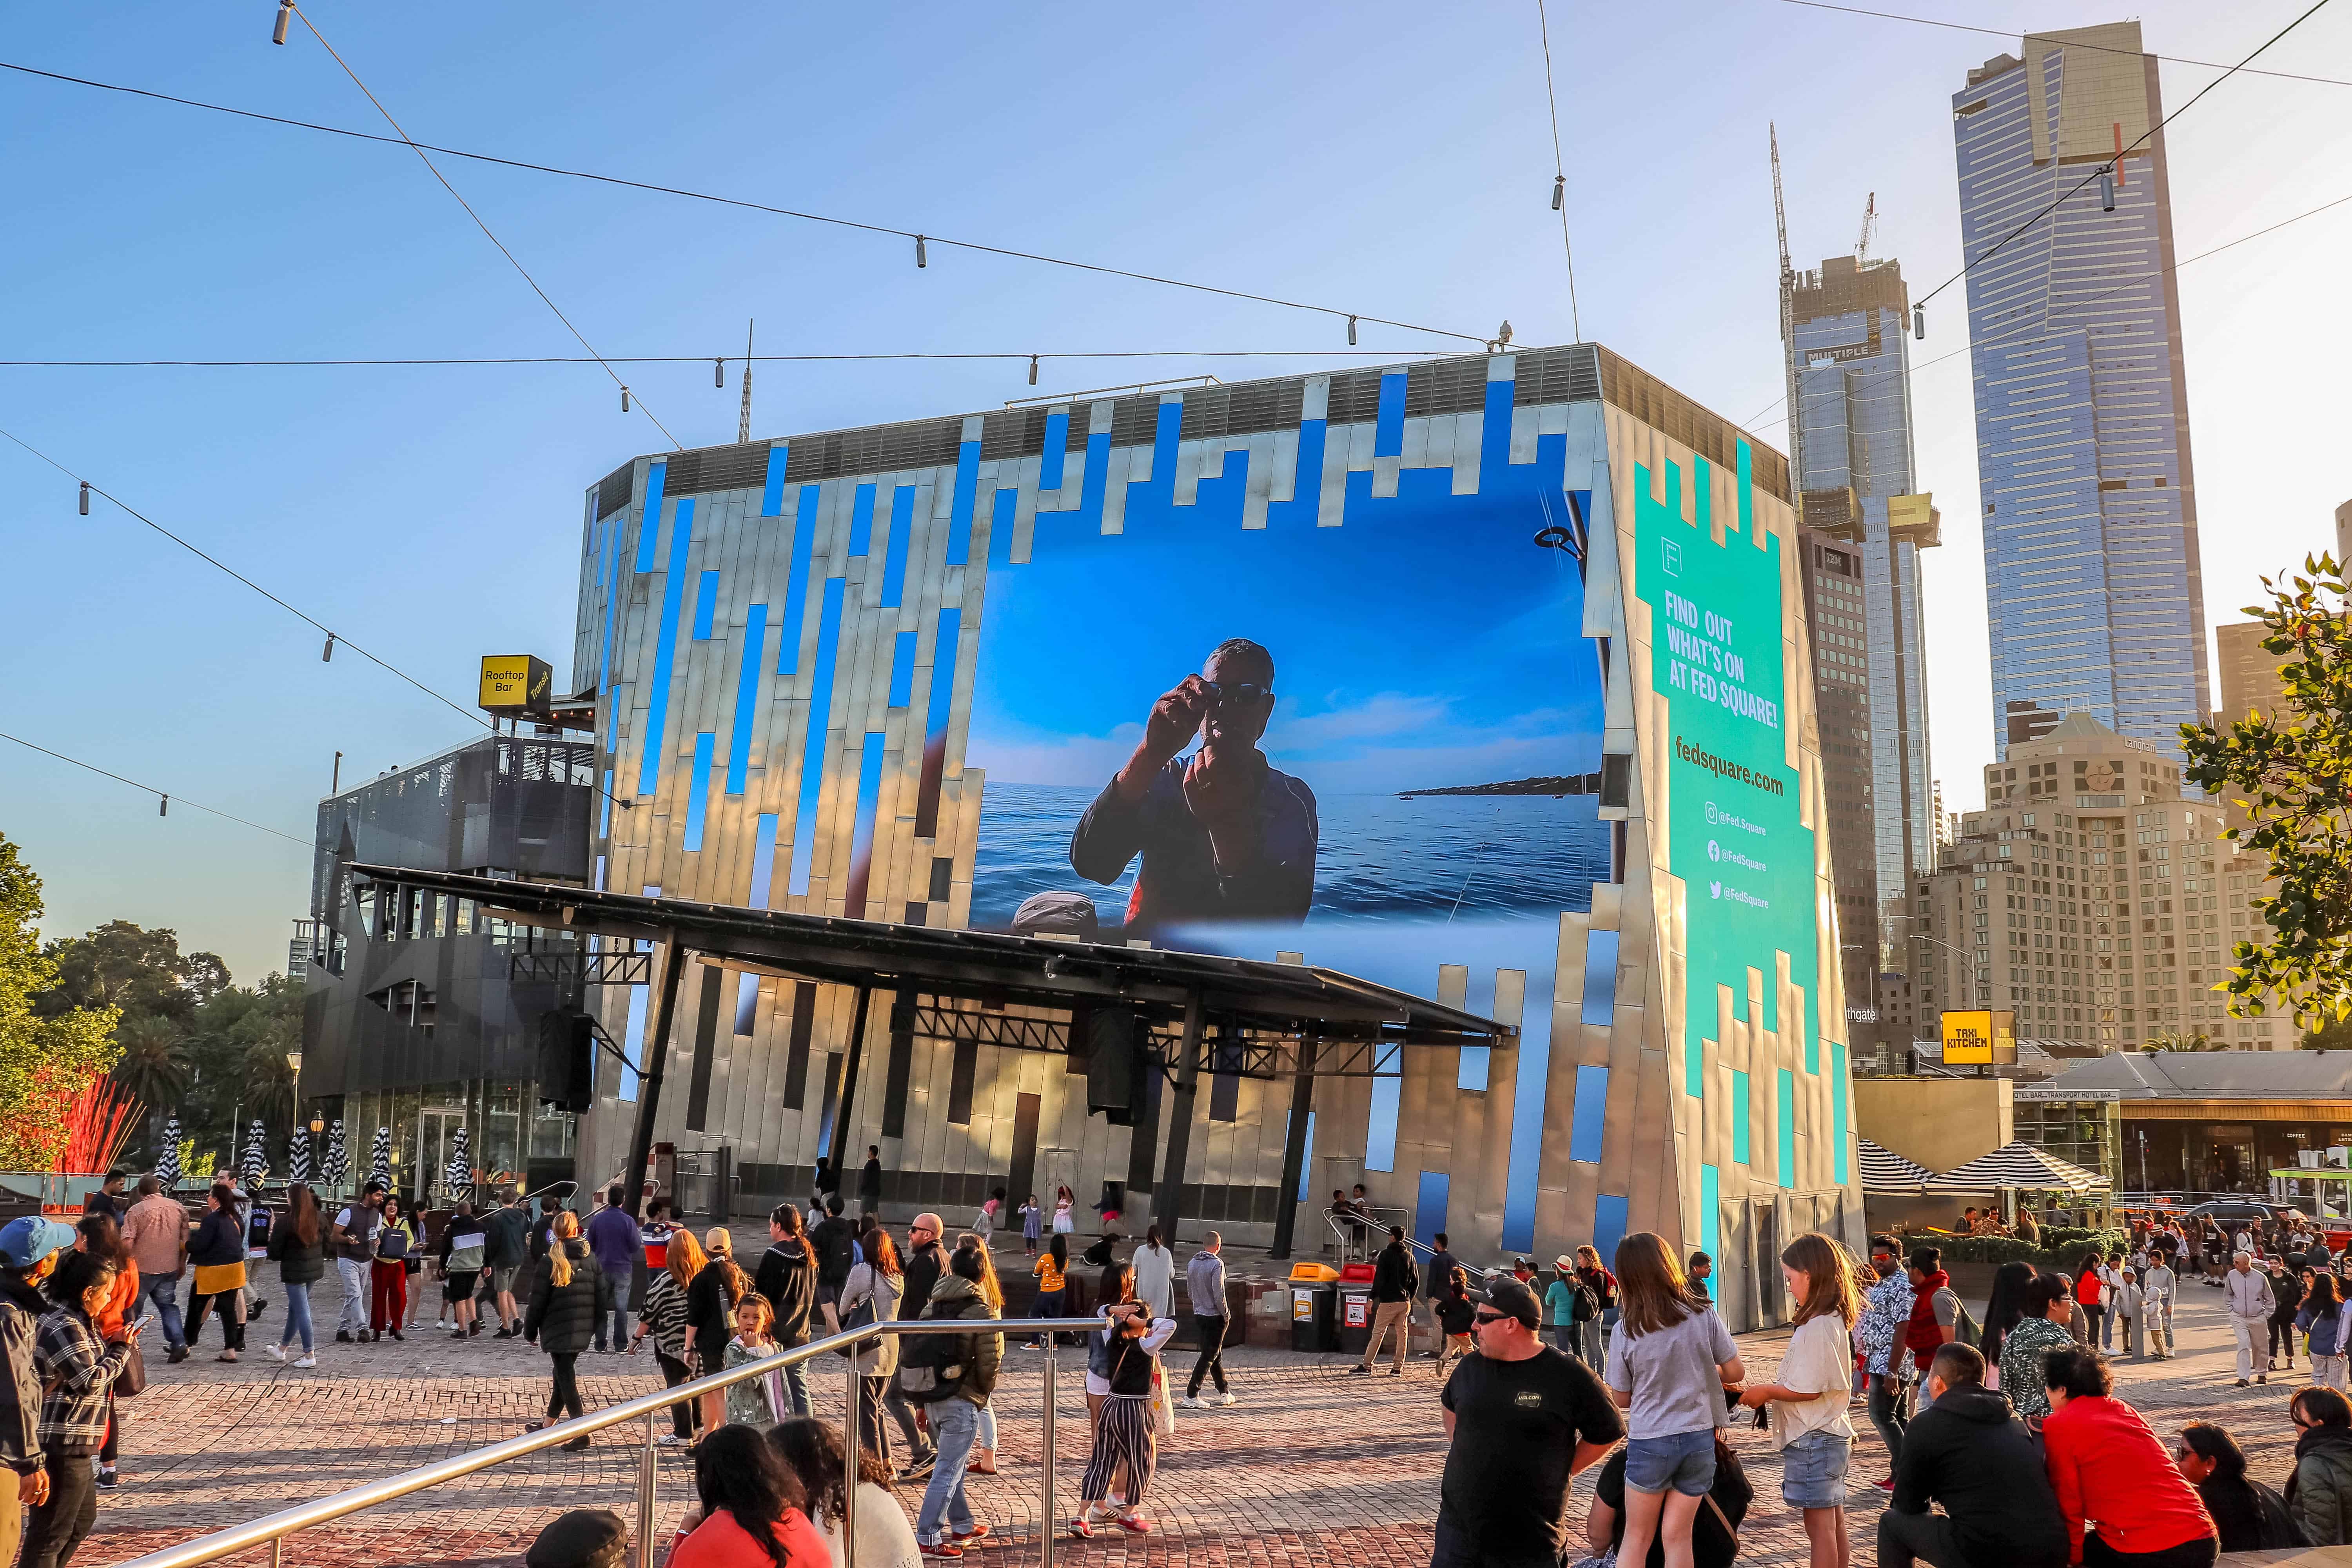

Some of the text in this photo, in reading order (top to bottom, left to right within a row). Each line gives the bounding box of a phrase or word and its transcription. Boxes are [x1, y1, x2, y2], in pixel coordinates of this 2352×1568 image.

[1826, 553, 1841, 566] IBM
[1665, 589, 1732, 646] FIND OUT
[485, 671, 524, 681] Rooftop
[1725, 651, 1744, 684] ON
[495, 682, 513, 691] Bar
[530, 670, 548, 700] Transit
[1670, 658, 1778, 730] AT FED SQUARE!
[2125, 736, 2157, 753] Langham
[1675, 735, 1784, 797] fedsquare.com
[1719, 811, 1766, 836] @Fed.Square
[1721, 849, 1766, 872] @FedSquare
[1724, 887, 1769, 909] @FedSquare
[1947, 1038, 1987, 1048] KITCHEN
[1956, 1028, 1977, 1038] TAXI
